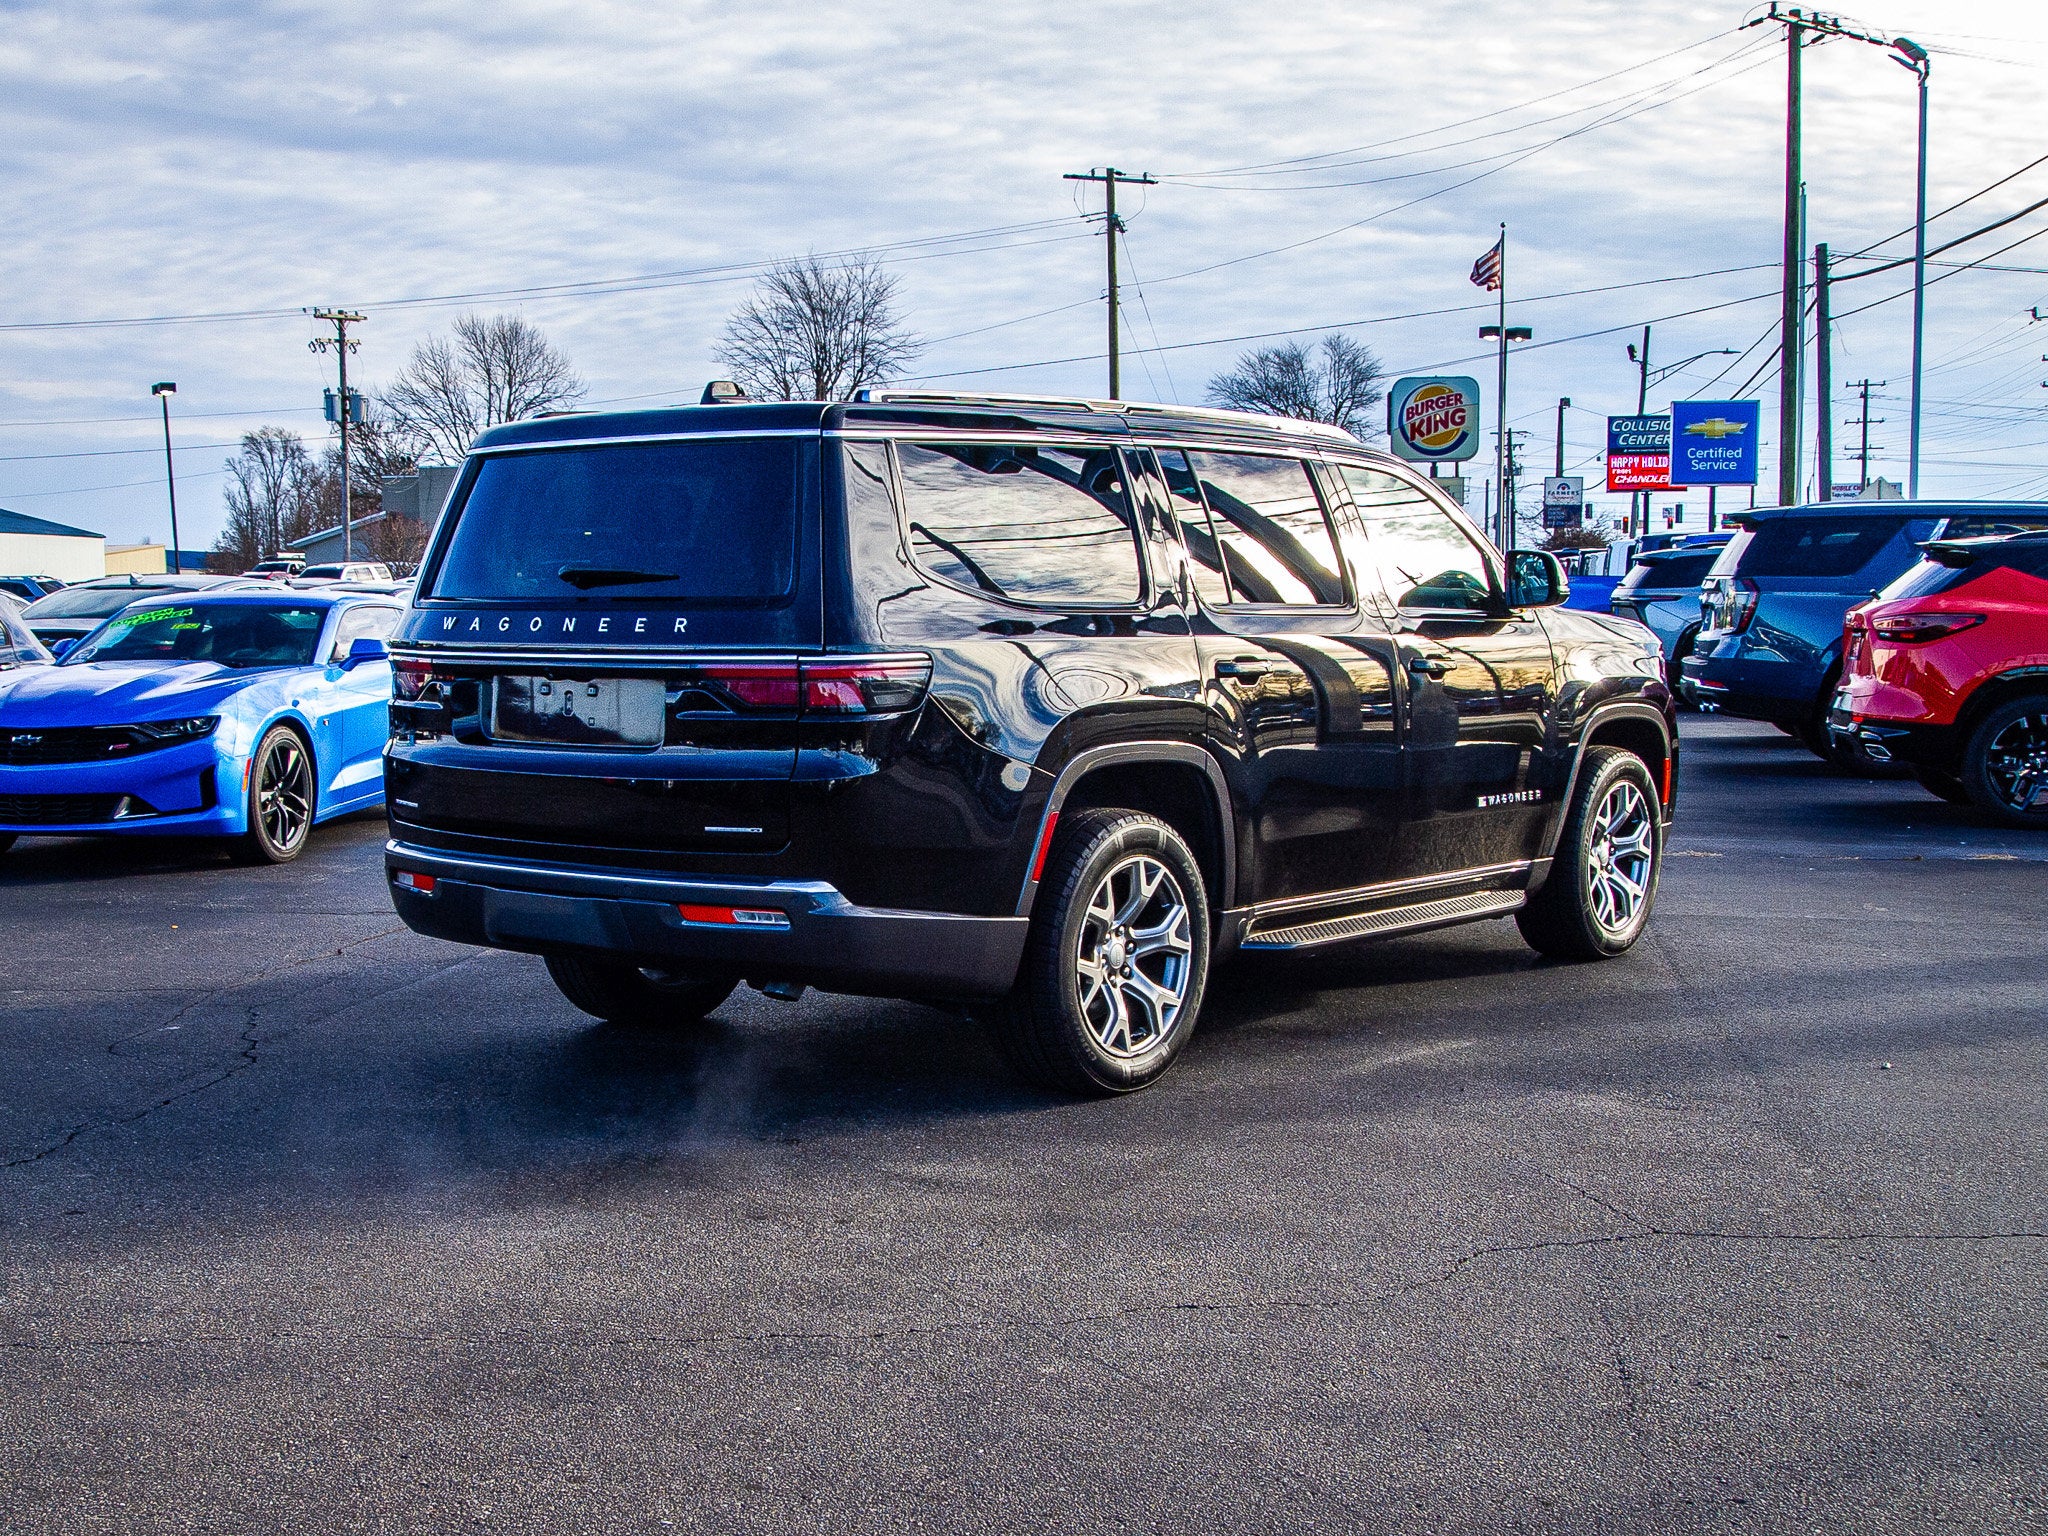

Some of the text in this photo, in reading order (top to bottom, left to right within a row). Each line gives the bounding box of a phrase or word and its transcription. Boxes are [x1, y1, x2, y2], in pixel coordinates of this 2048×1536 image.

[1405, 392, 1464, 422] BURGER
[1408, 407, 1467, 442] KING
[1687, 447, 1742, 459] Certified
[1611, 456, 1639, 468] HAPPY
[1691, 459, 1737, 470] Service
[1614, 474, 1670, 483] CHANDLE
[442, 616, 688, 633] WAGONEER
[1487, 789, 1541, 806] WAGONEER
